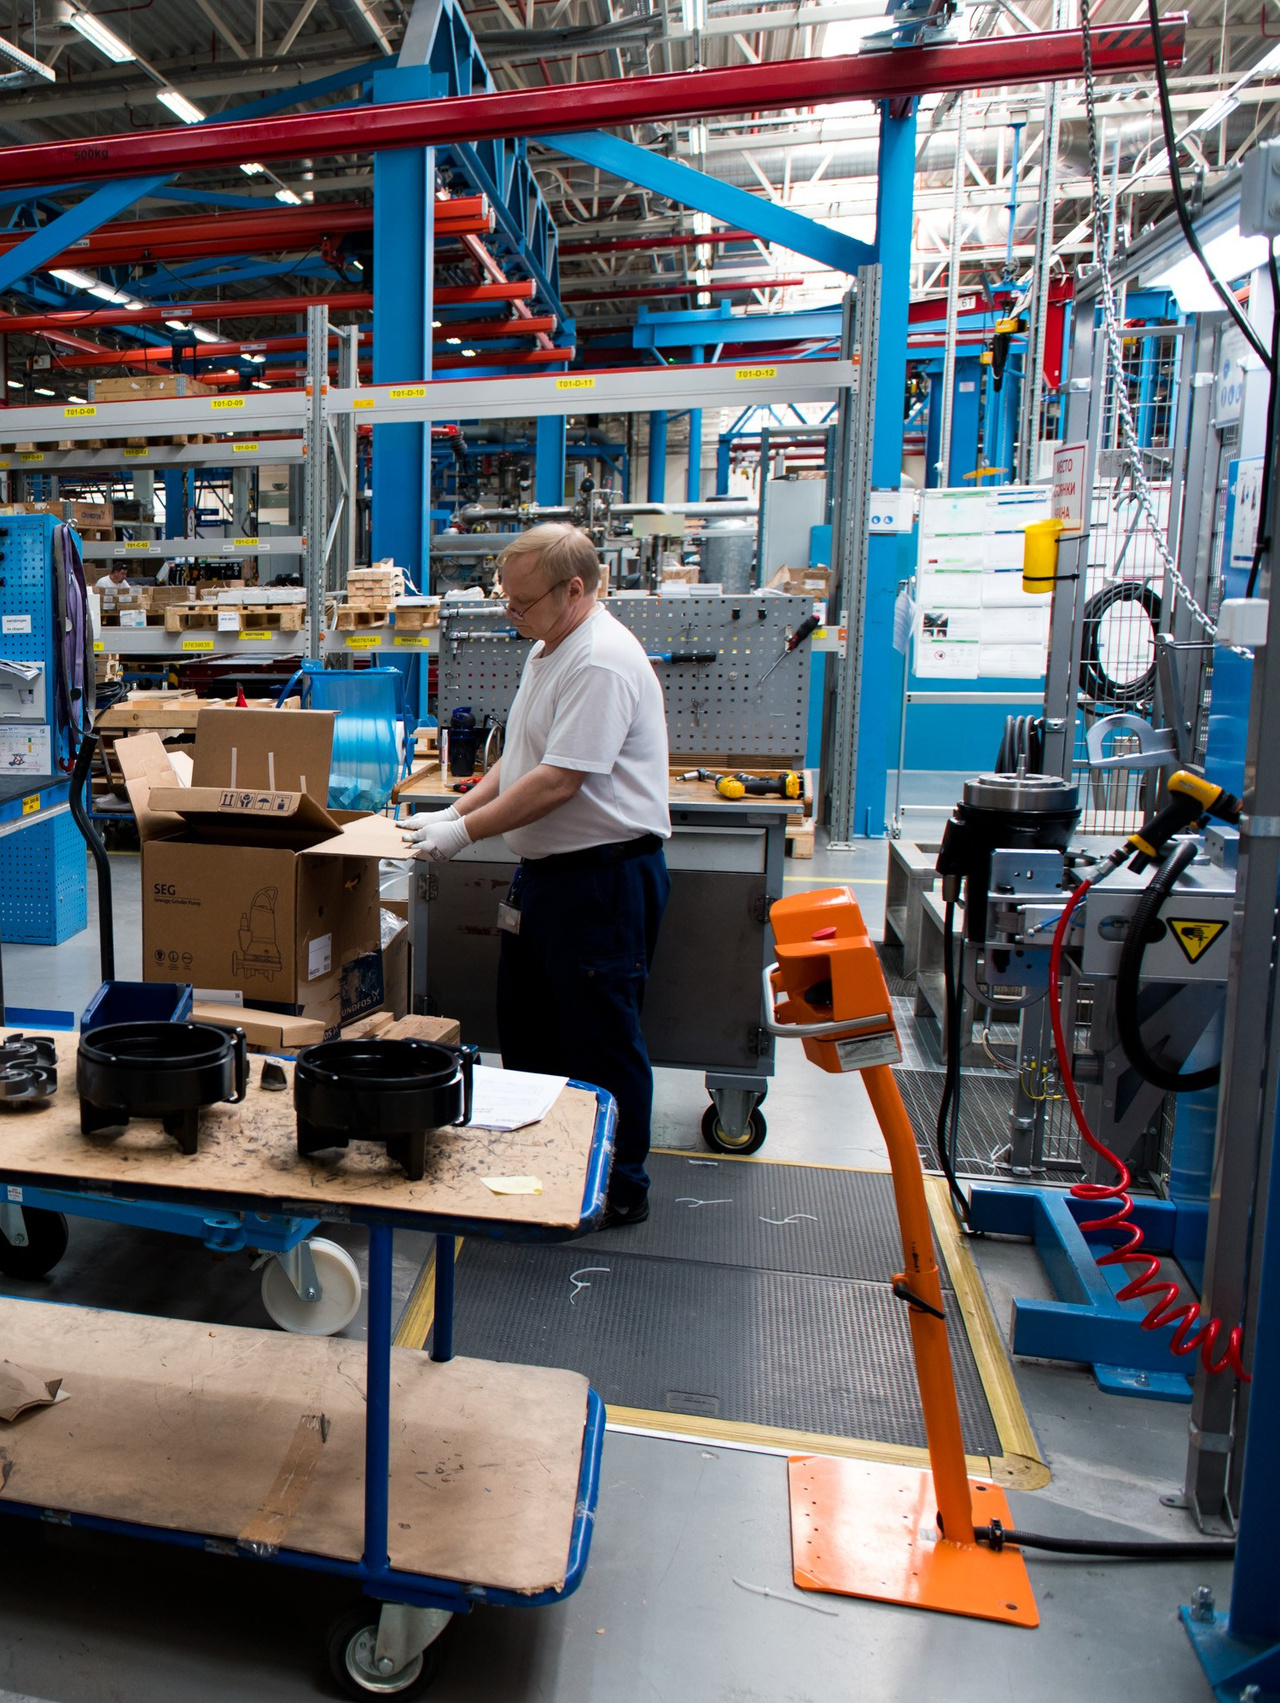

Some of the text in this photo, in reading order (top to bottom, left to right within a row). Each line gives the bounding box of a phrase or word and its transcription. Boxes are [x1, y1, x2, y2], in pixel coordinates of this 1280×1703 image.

[737, 369, 775, 378] T01-D-12
[558, 379, 593, 388] T01-D-11
[392, 388, 425, 398] T01-D-10
[213, 400, 244, 408] T01-D-09
[66, 408, 95, 416] T01-D-08
[1056, 458, 1073, 474] МЕСТО
[154, 883, 176, 895] SEG
